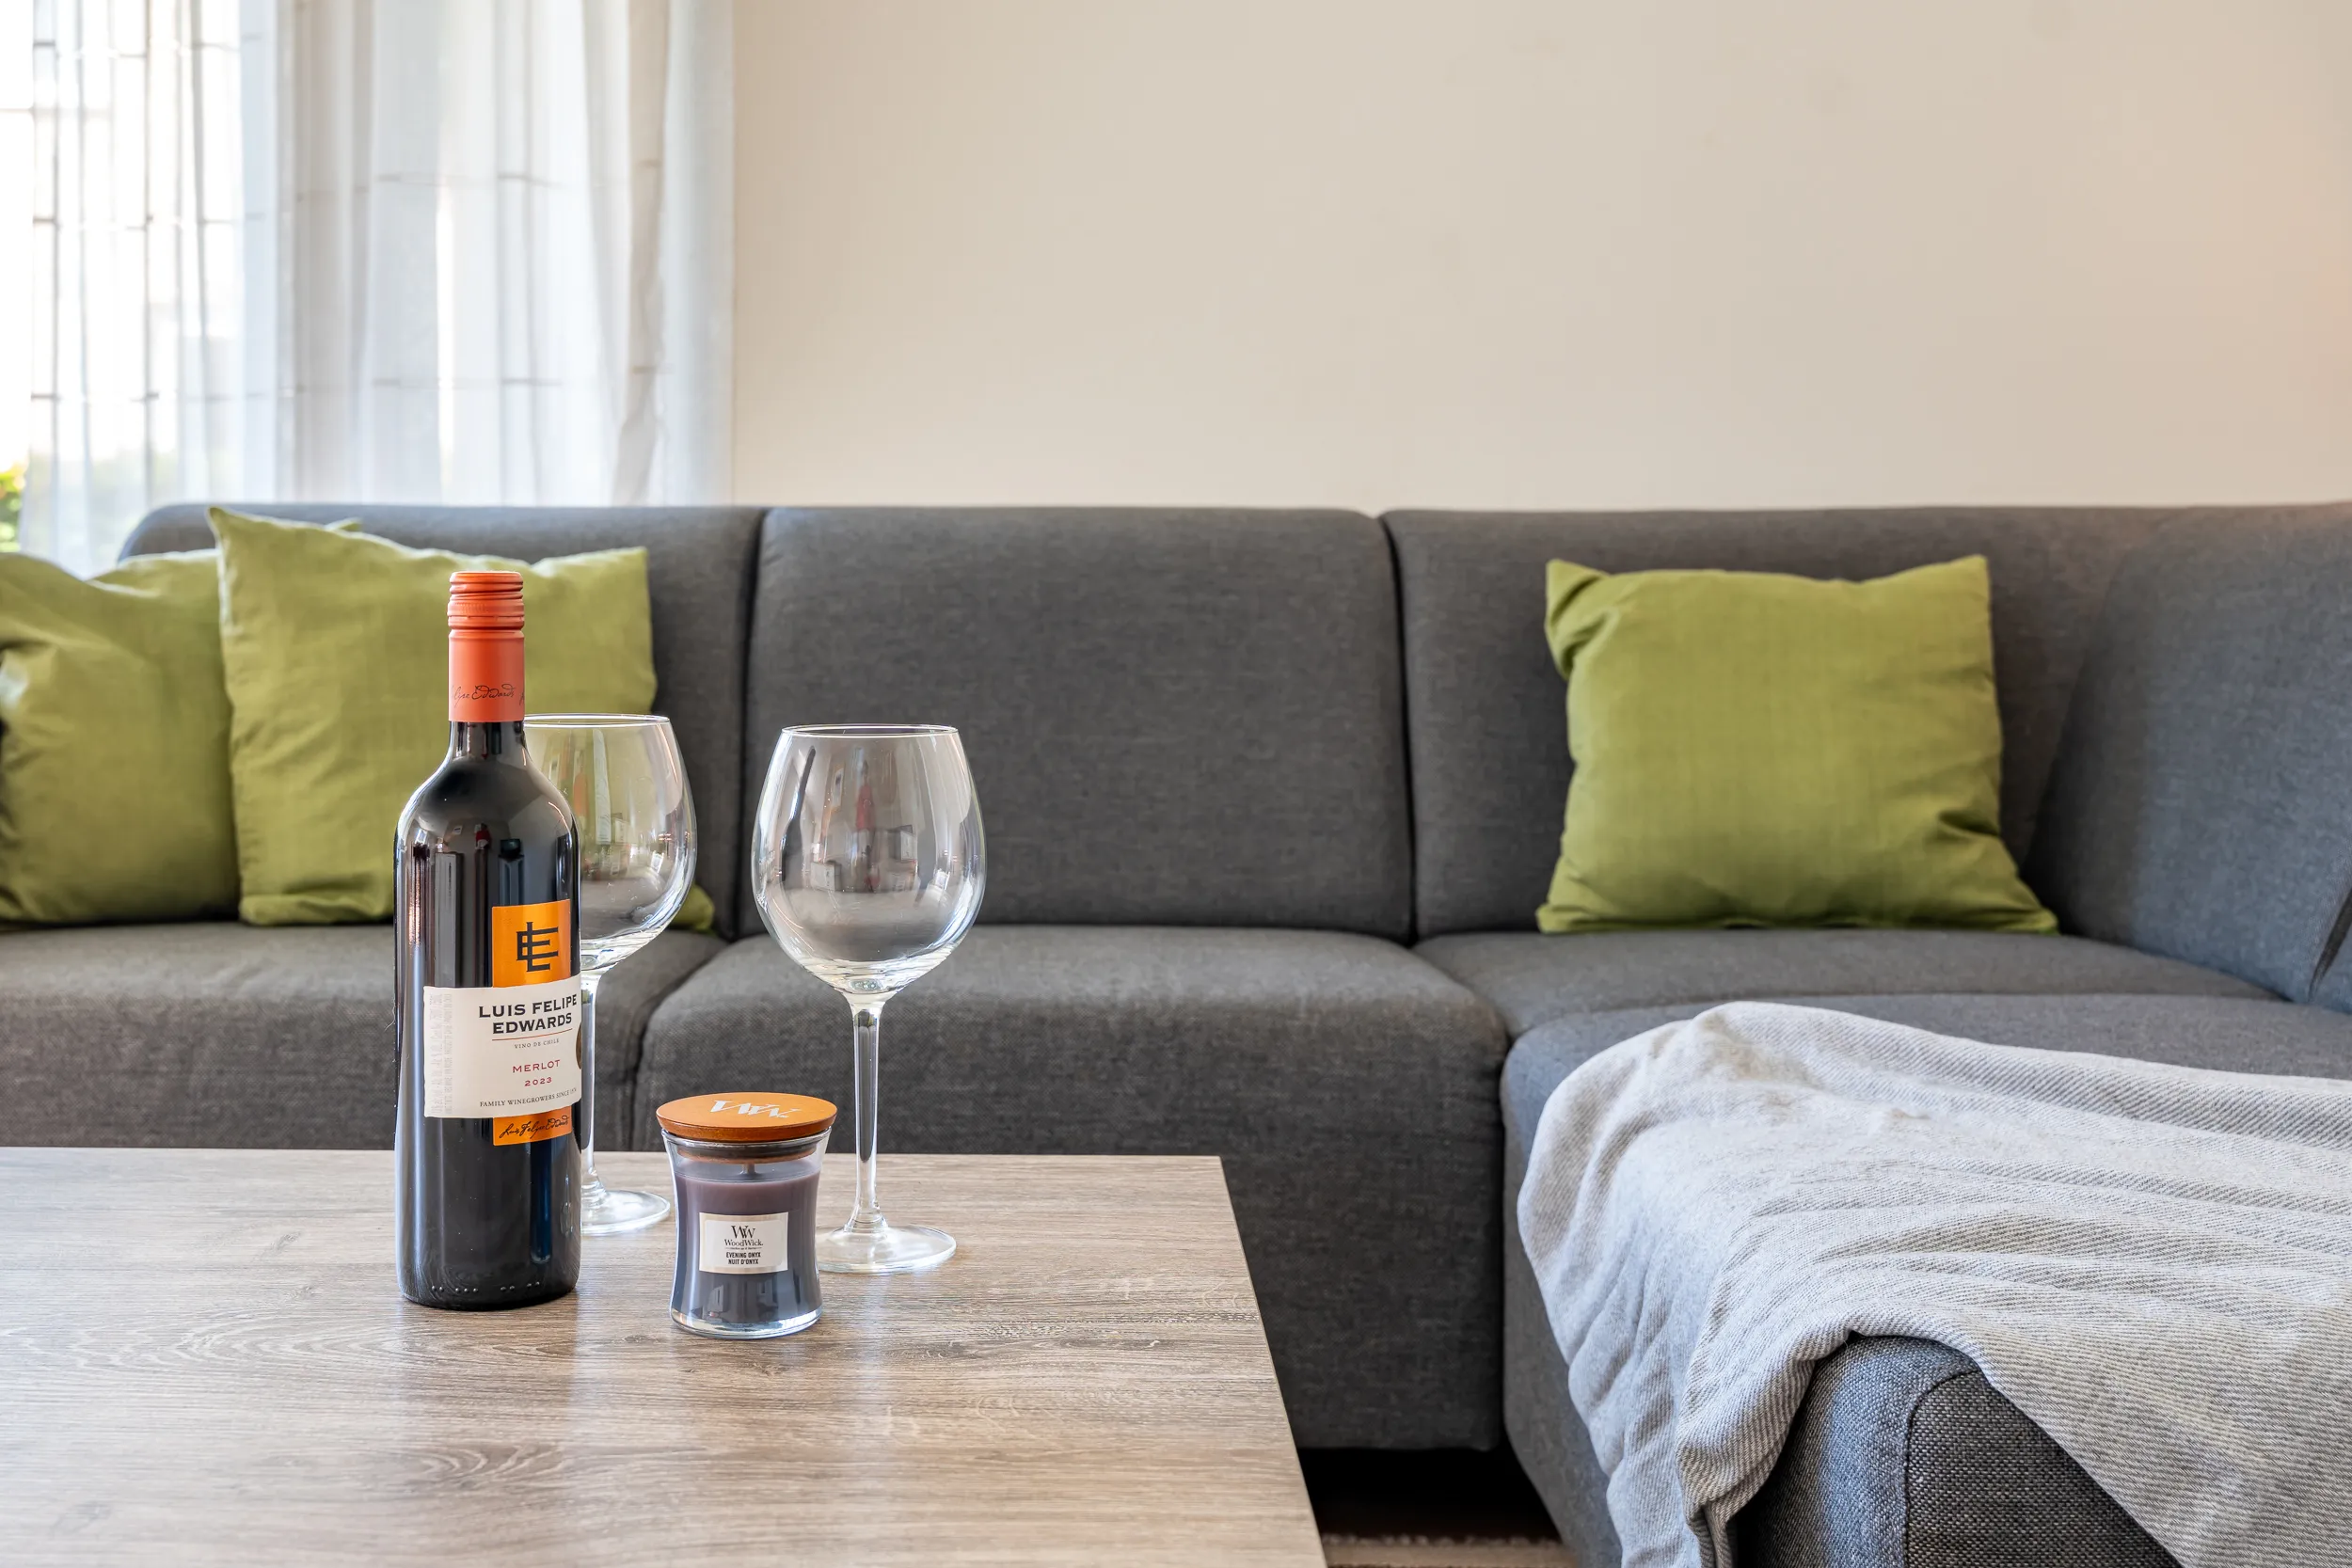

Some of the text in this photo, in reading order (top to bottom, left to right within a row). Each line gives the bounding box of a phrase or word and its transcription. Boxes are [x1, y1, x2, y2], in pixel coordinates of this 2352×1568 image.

[479, 993, 578, 1019] LUIS FELIPE
[492, 1012, 572, 1035] EDWARDS
[543, 1037, 560, 1046] CHILE
[512, 1059, 561, 1073] MERLOT
[524, 1076, 553, 1087] 2023
[507, 1093, 555, 1106] WINEGROWERS
[556, 1089, 569, 1099] SINCE
